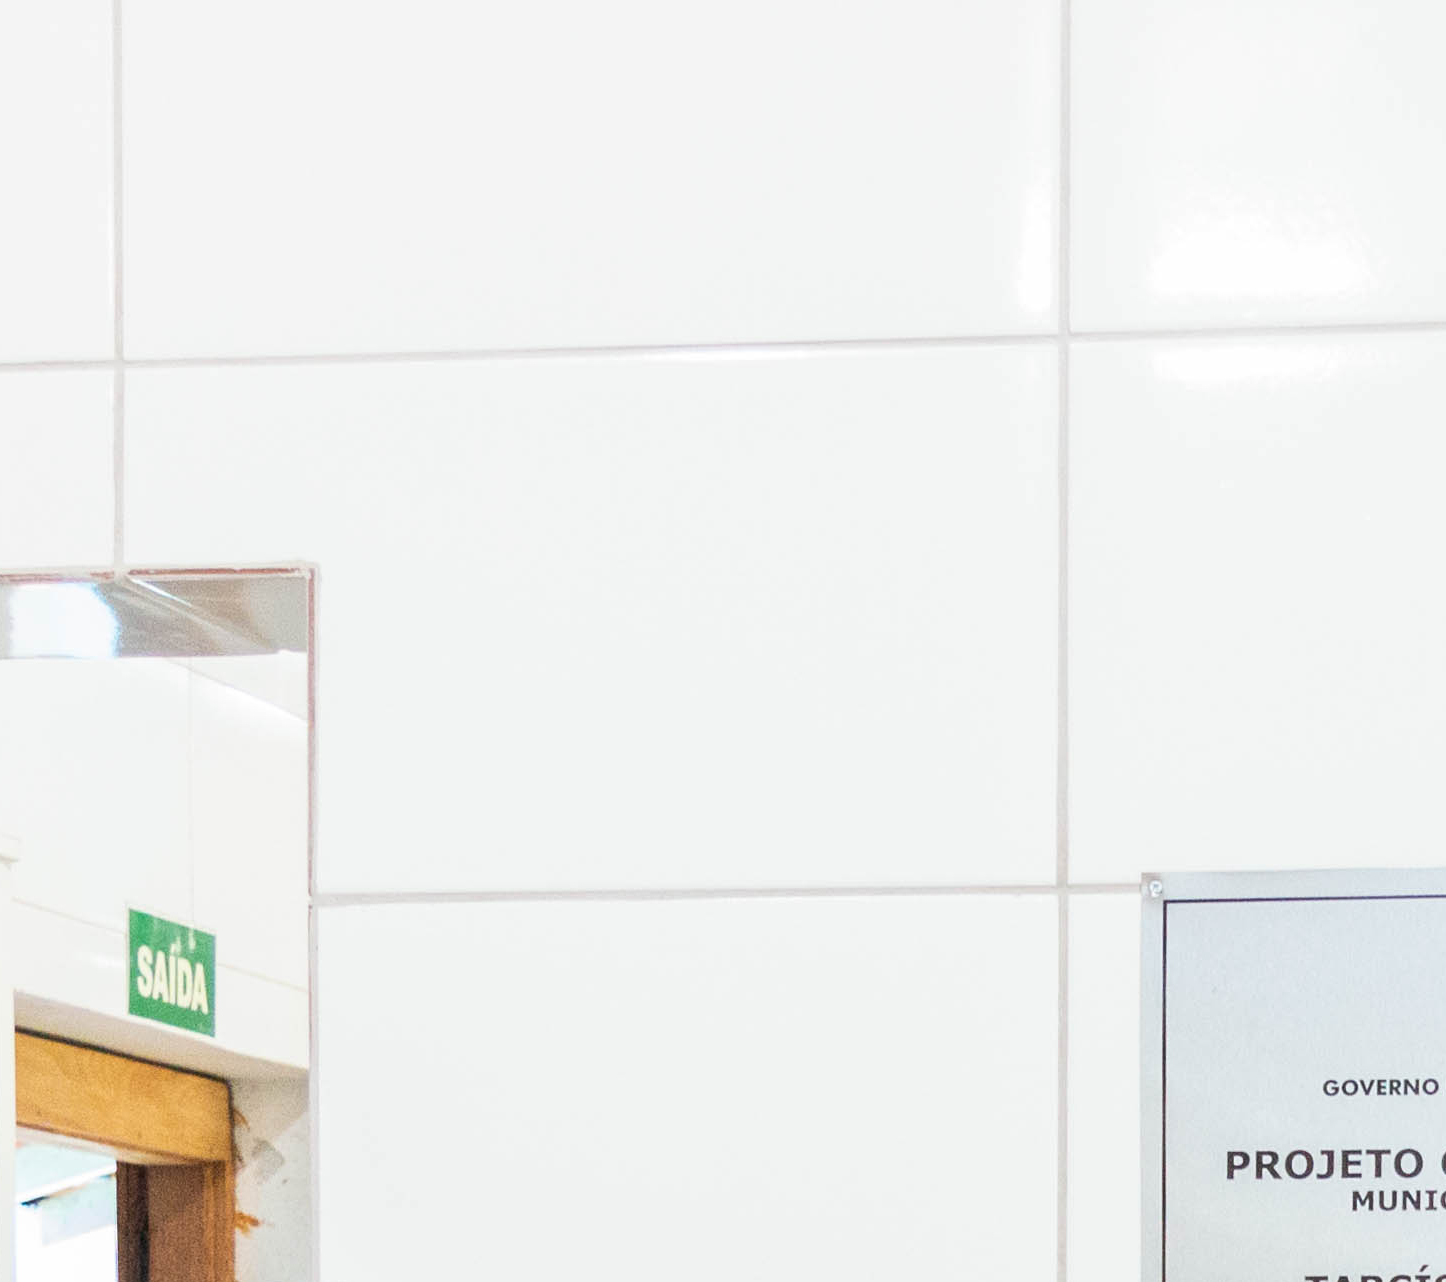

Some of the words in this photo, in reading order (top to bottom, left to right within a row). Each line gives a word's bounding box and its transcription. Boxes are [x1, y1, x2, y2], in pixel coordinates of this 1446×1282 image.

[136, 936, 209, 1015] SAÍDA
[1322, 1077, 1440, 1097] GOVERNO
[1226, 1147, 1424, 1181] PROJETO
